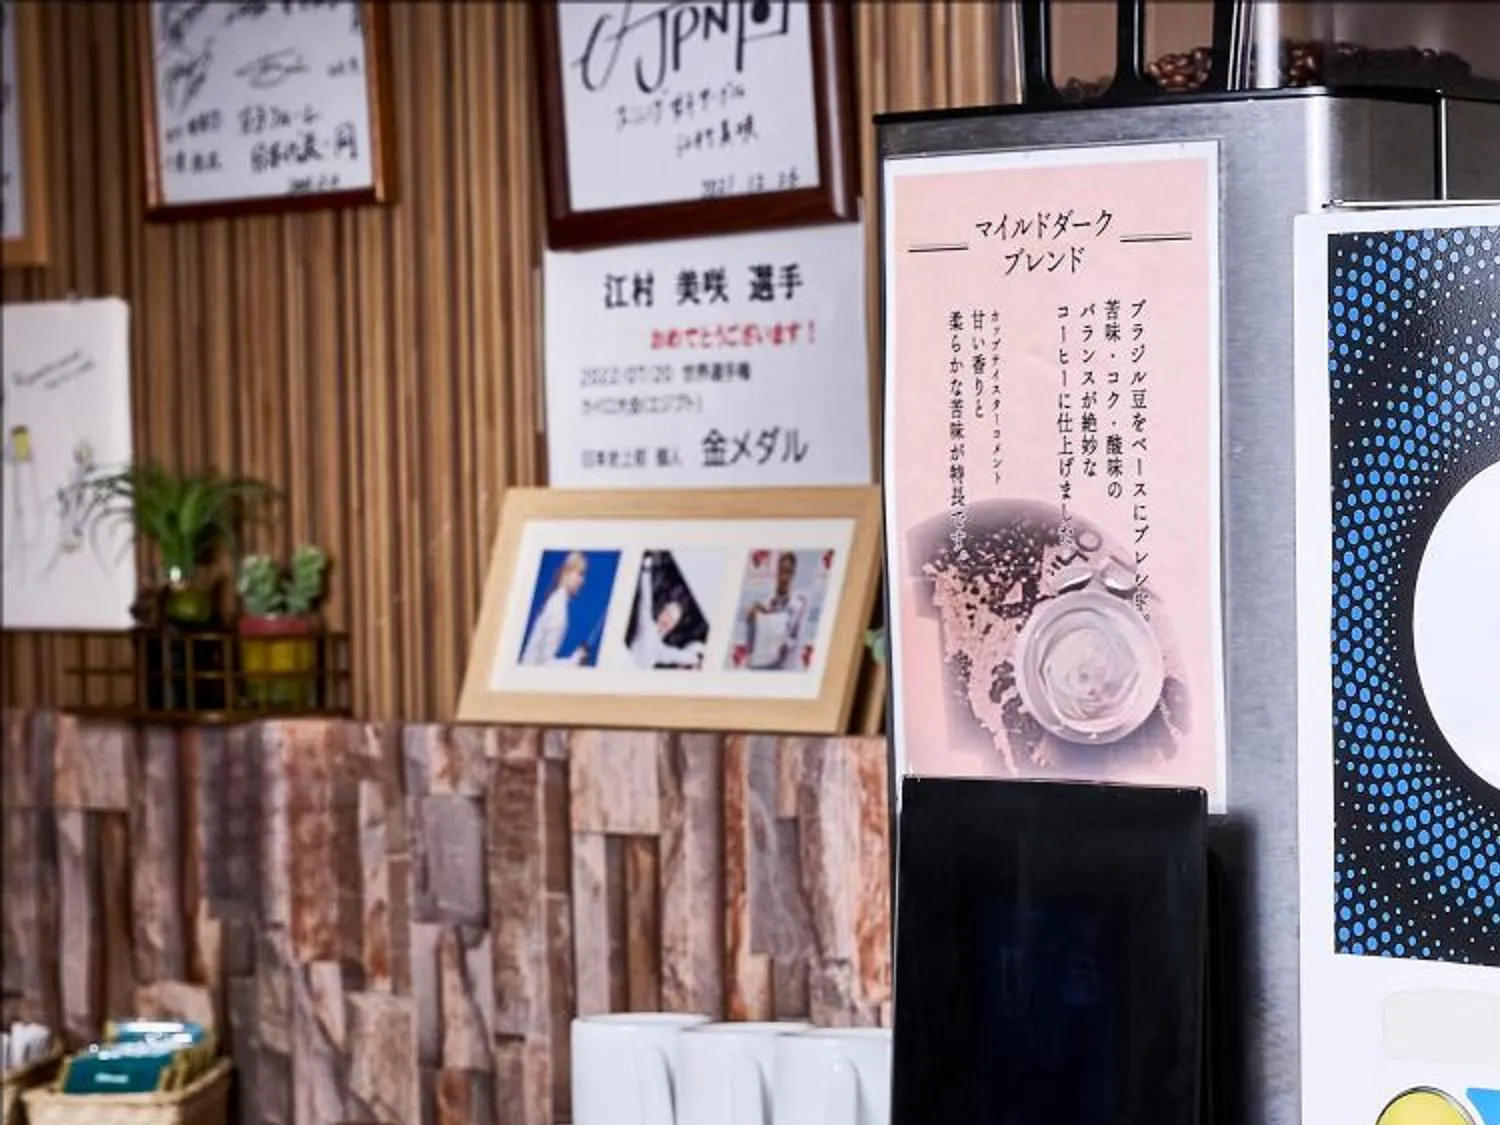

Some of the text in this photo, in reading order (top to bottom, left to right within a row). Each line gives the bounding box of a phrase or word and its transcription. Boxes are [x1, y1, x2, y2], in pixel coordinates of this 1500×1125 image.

[974, 208, 1113, 242] マイルドダーク
[1003, 247, 1085, 276] ブレンド
[602, 263, 804, 309] 江村 美咲 選手
[971, 309, 985, 419] 甘い香りと
[1080, 302, 1098, 478] バランスが絶妙な
[1105, 299, 1123, 499] 苦味・コク・酸味の
[701, 425, 810, 467] 金メダル
